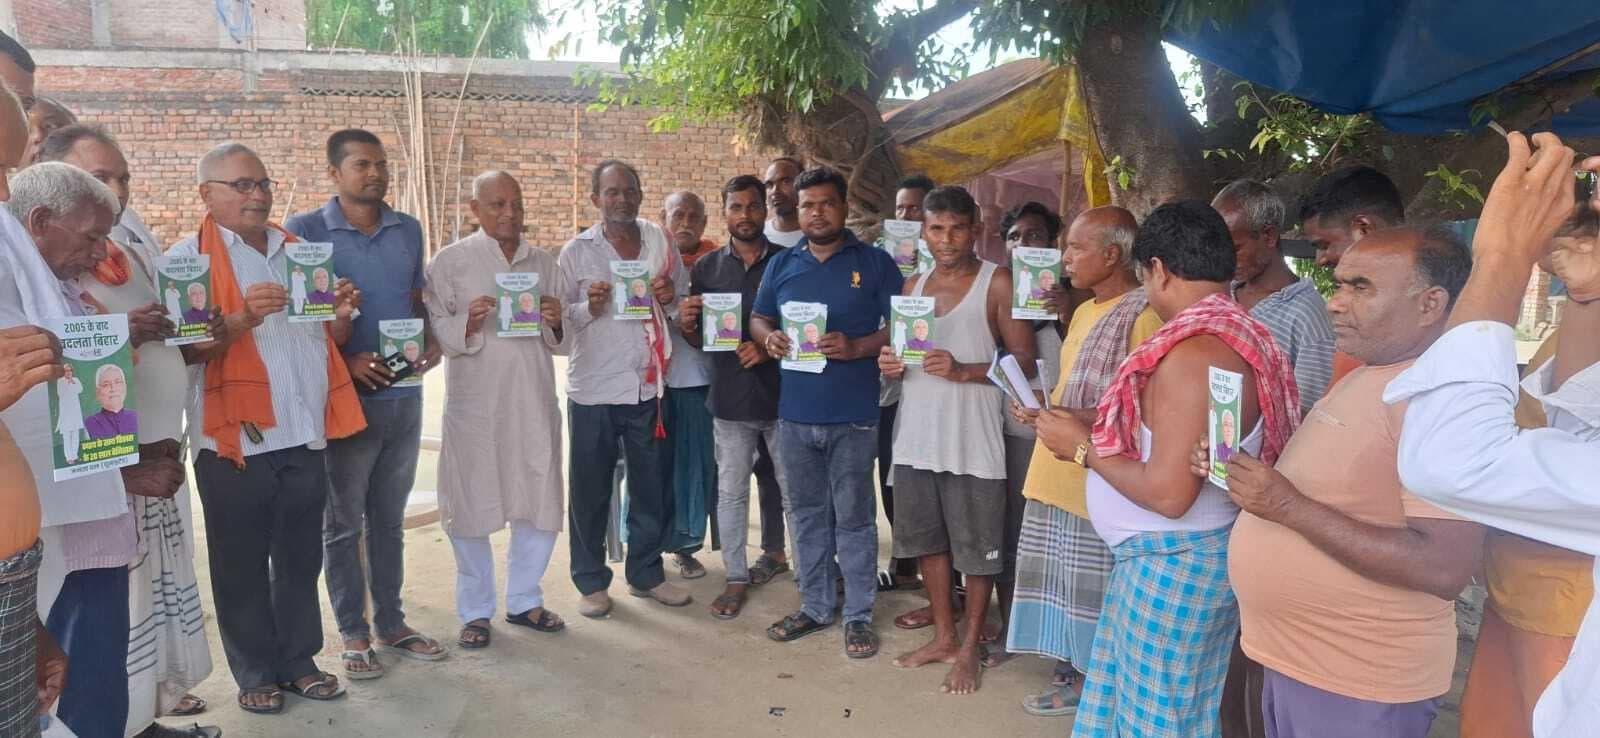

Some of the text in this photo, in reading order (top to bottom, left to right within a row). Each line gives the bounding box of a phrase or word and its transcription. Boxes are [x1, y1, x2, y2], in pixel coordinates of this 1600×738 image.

[64, 322, 86, 333] 2005
[87, 320, 94, 331] के
[93, 333, 119, 346] बिहार
